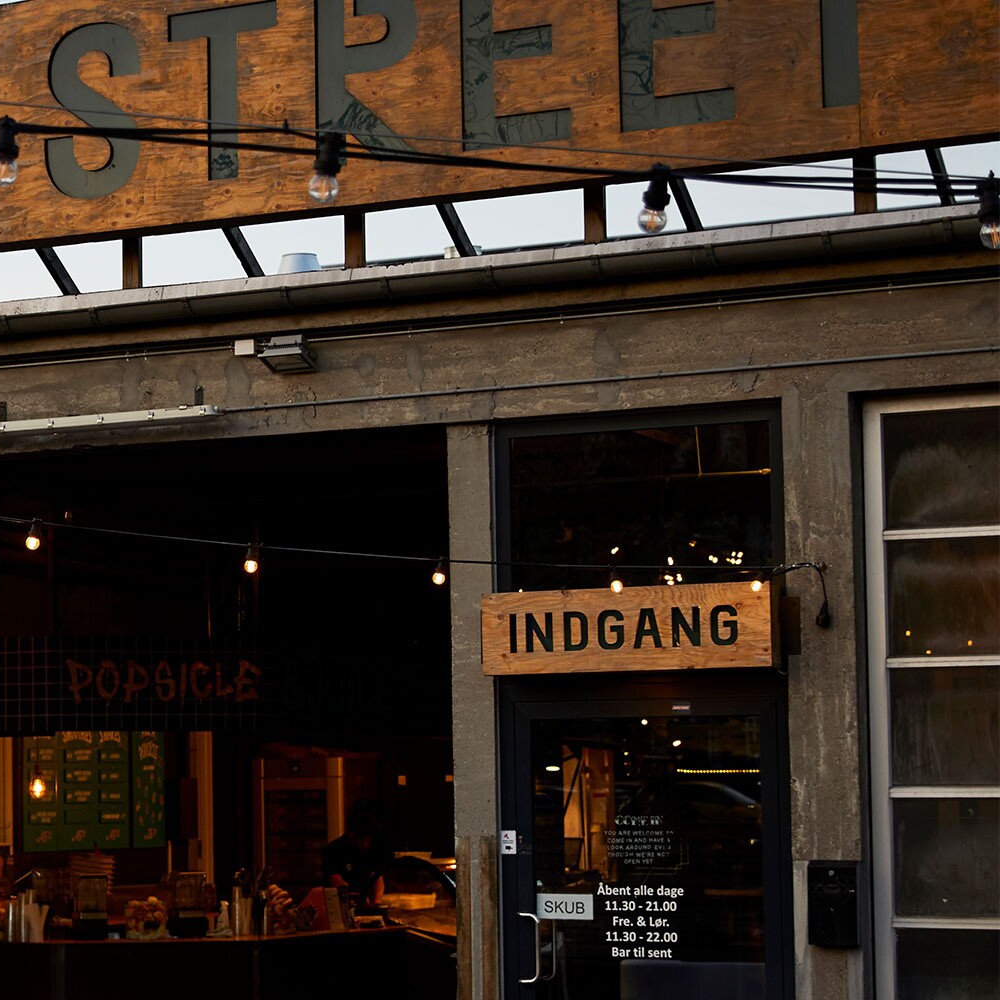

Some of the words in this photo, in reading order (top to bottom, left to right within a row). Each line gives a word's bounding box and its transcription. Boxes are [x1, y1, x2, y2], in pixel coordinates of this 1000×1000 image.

[509, 604, 739, 653] INDGANG
[66, 658, 263, 704] POPSICLE
[597, 882, 631, 896] Åbent
[633, 885, 654, 896] alle
[656, 885, 684, 898] dage
[544, 900, 585, 914] SKUB
[604, 900, 636, 911] 11.30
[645, 901, 677, 911] 21.00
[612, 916, 634, 927] Fre.
[636, 916, 647, 927] &
[649, 916, 670, 928] Lør.
[605, 931, 637, 942] 11.30
[646, 932, 678, 943] 22.00
[611, 946, 631, 957] Bar
[633, 947, 645, 958] til
[647, 948, 673, 958] sent
